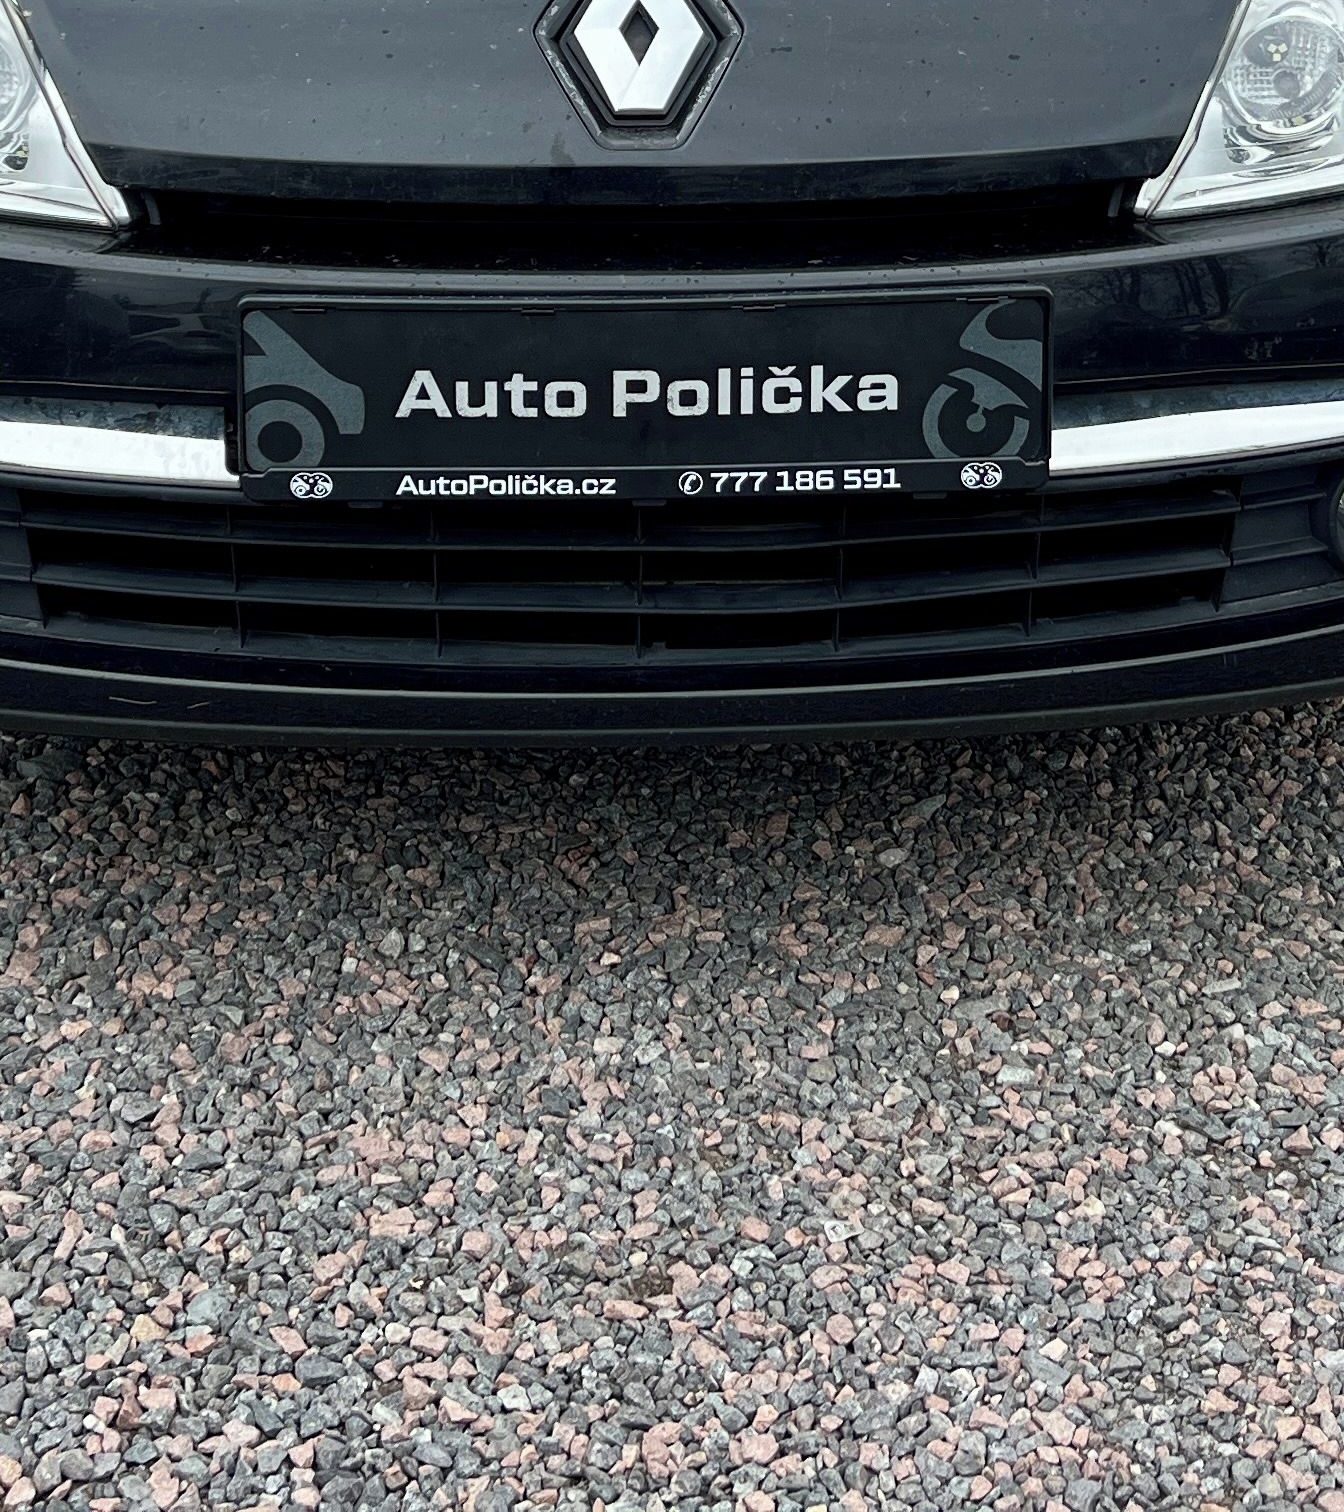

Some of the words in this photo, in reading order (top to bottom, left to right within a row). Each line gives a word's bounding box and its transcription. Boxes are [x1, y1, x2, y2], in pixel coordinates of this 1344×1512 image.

[394, 370, 588, 419] Auto
[612, 364, 900, 418] Polička
[395, 472, 617, 497] AutoPolička.cz
[710, 471, 765, 493] 777
[774, 470, 837, 491] 186
[842, 468, 902, 490] 591
